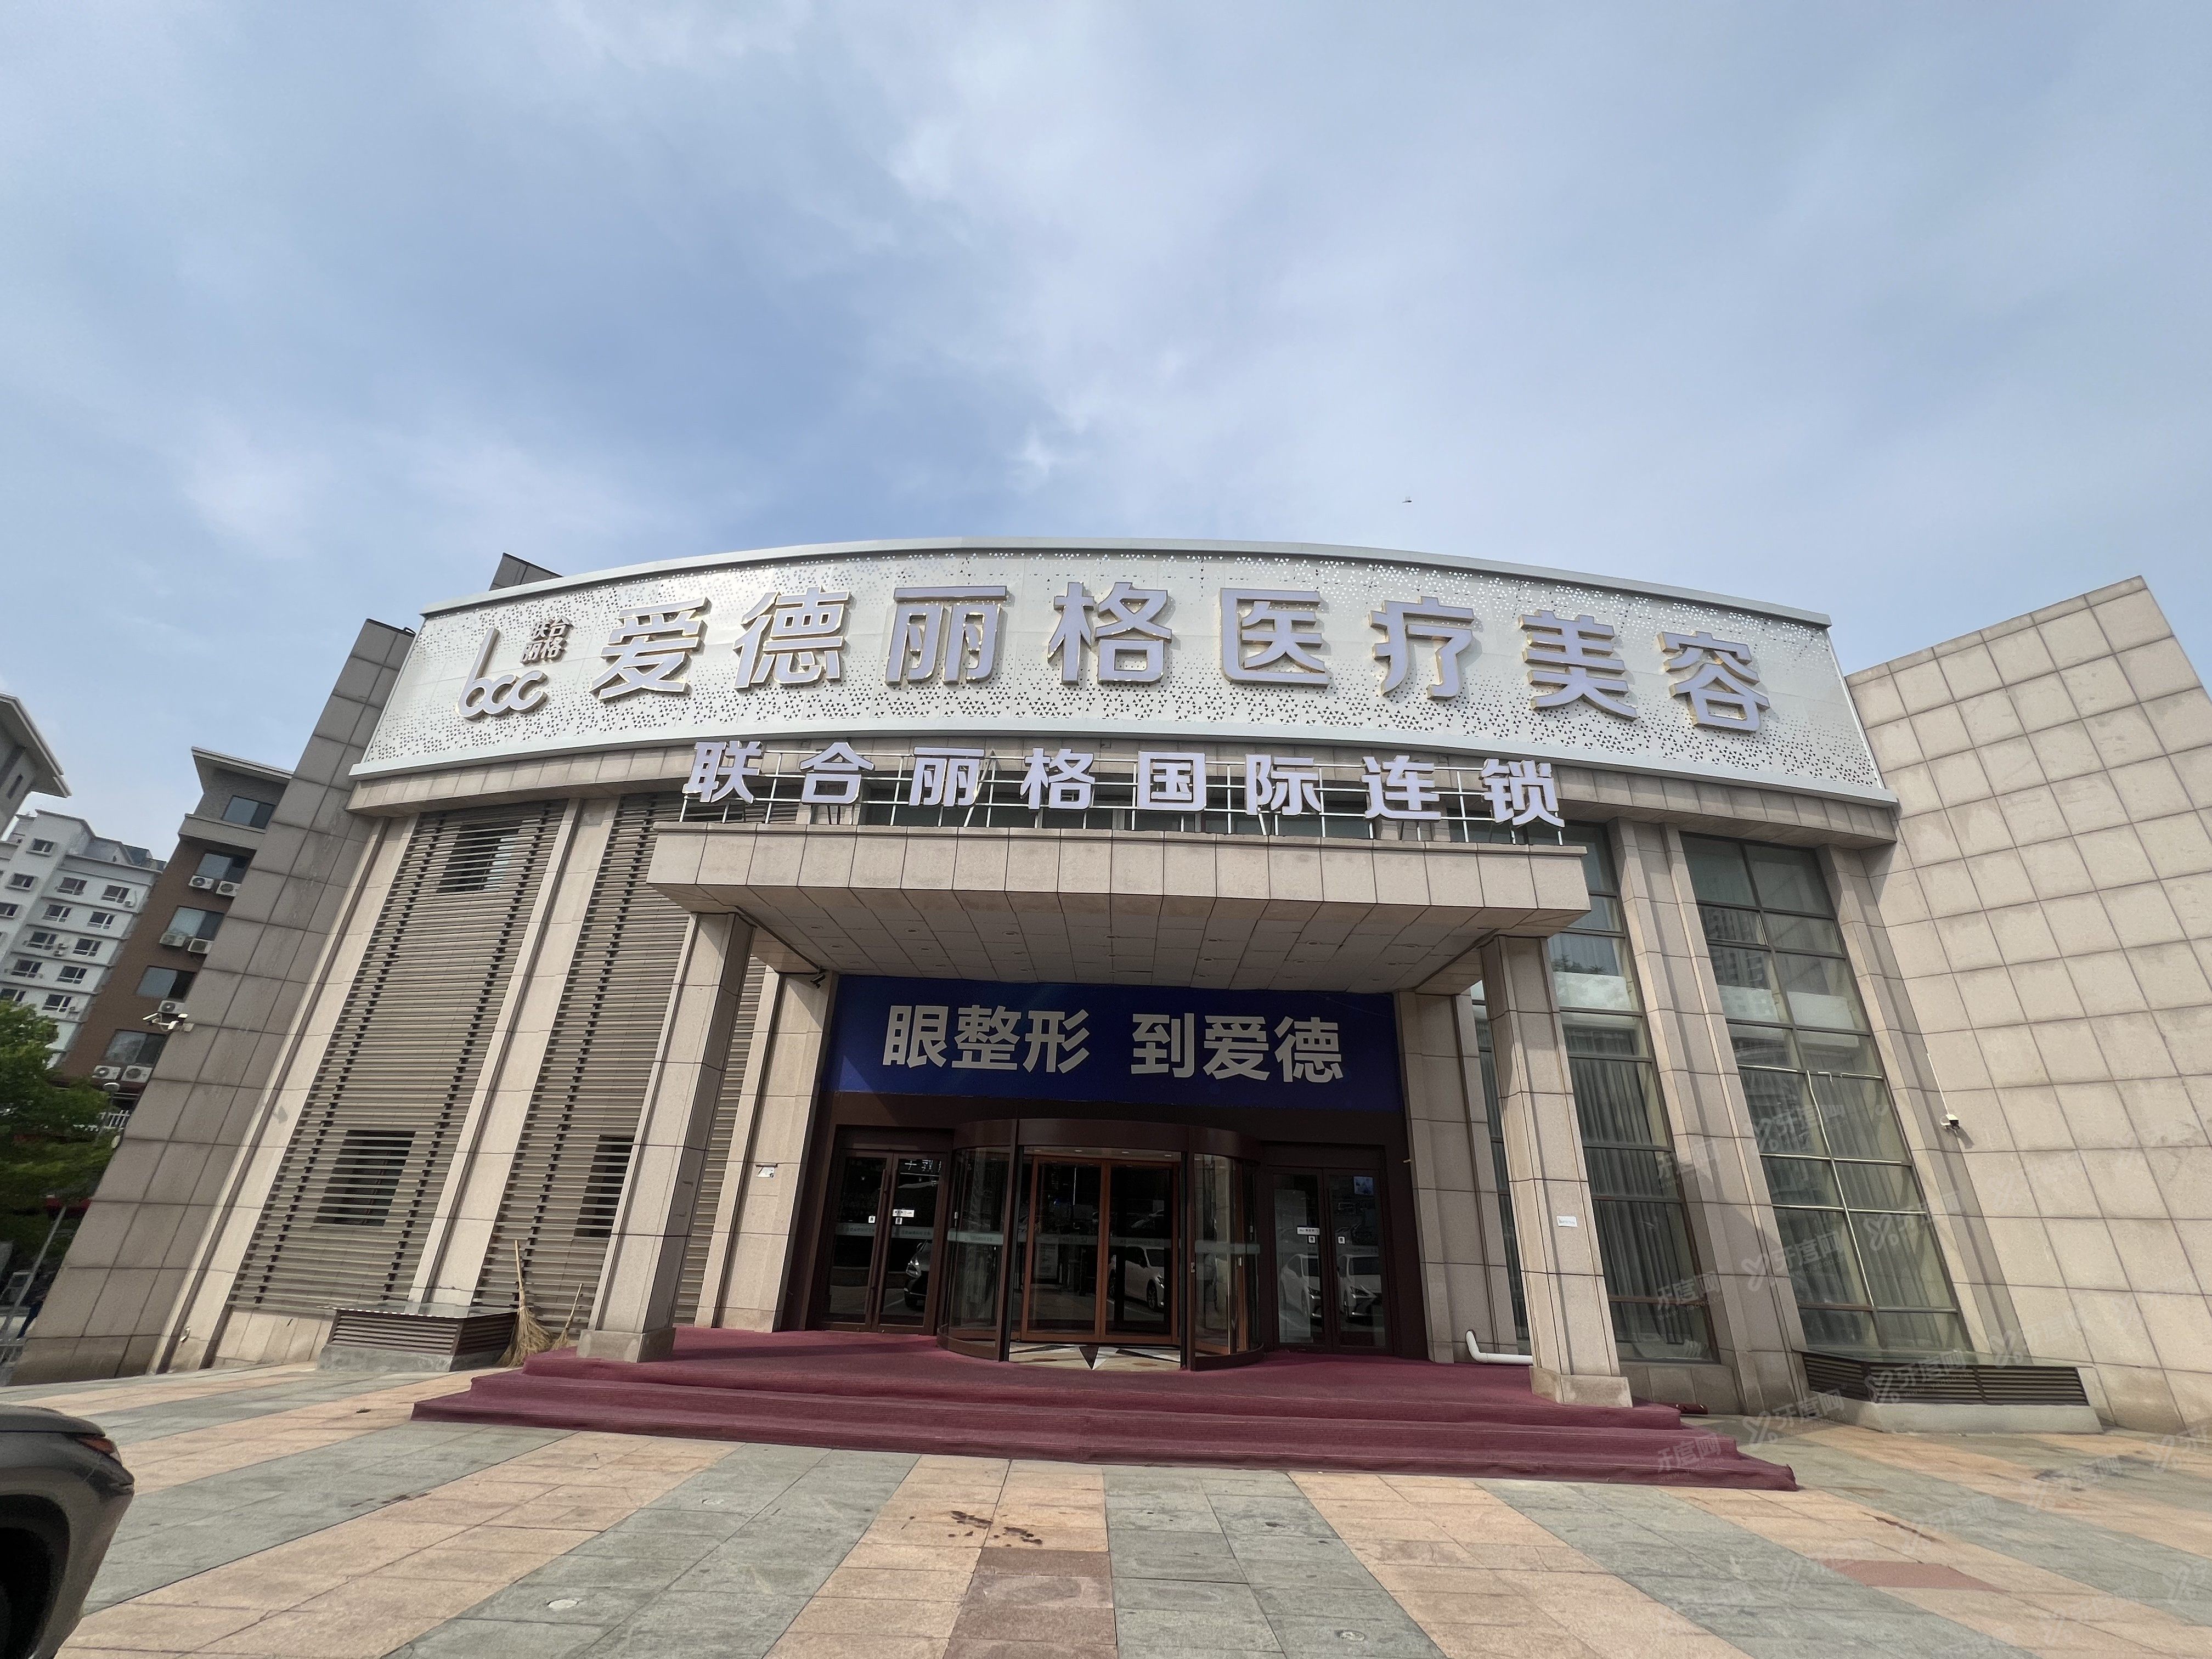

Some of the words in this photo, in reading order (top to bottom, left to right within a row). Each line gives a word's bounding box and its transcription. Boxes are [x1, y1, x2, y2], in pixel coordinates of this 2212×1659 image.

[589, 582, 1771, 732] 爱德丽格医疗美容
[681, 740, 1566, 828] 联合丽格国际连锁
[882, 1005, 1090, 1074] 眼整形
[1130, 1012, 1345, 1084] 到爱德
